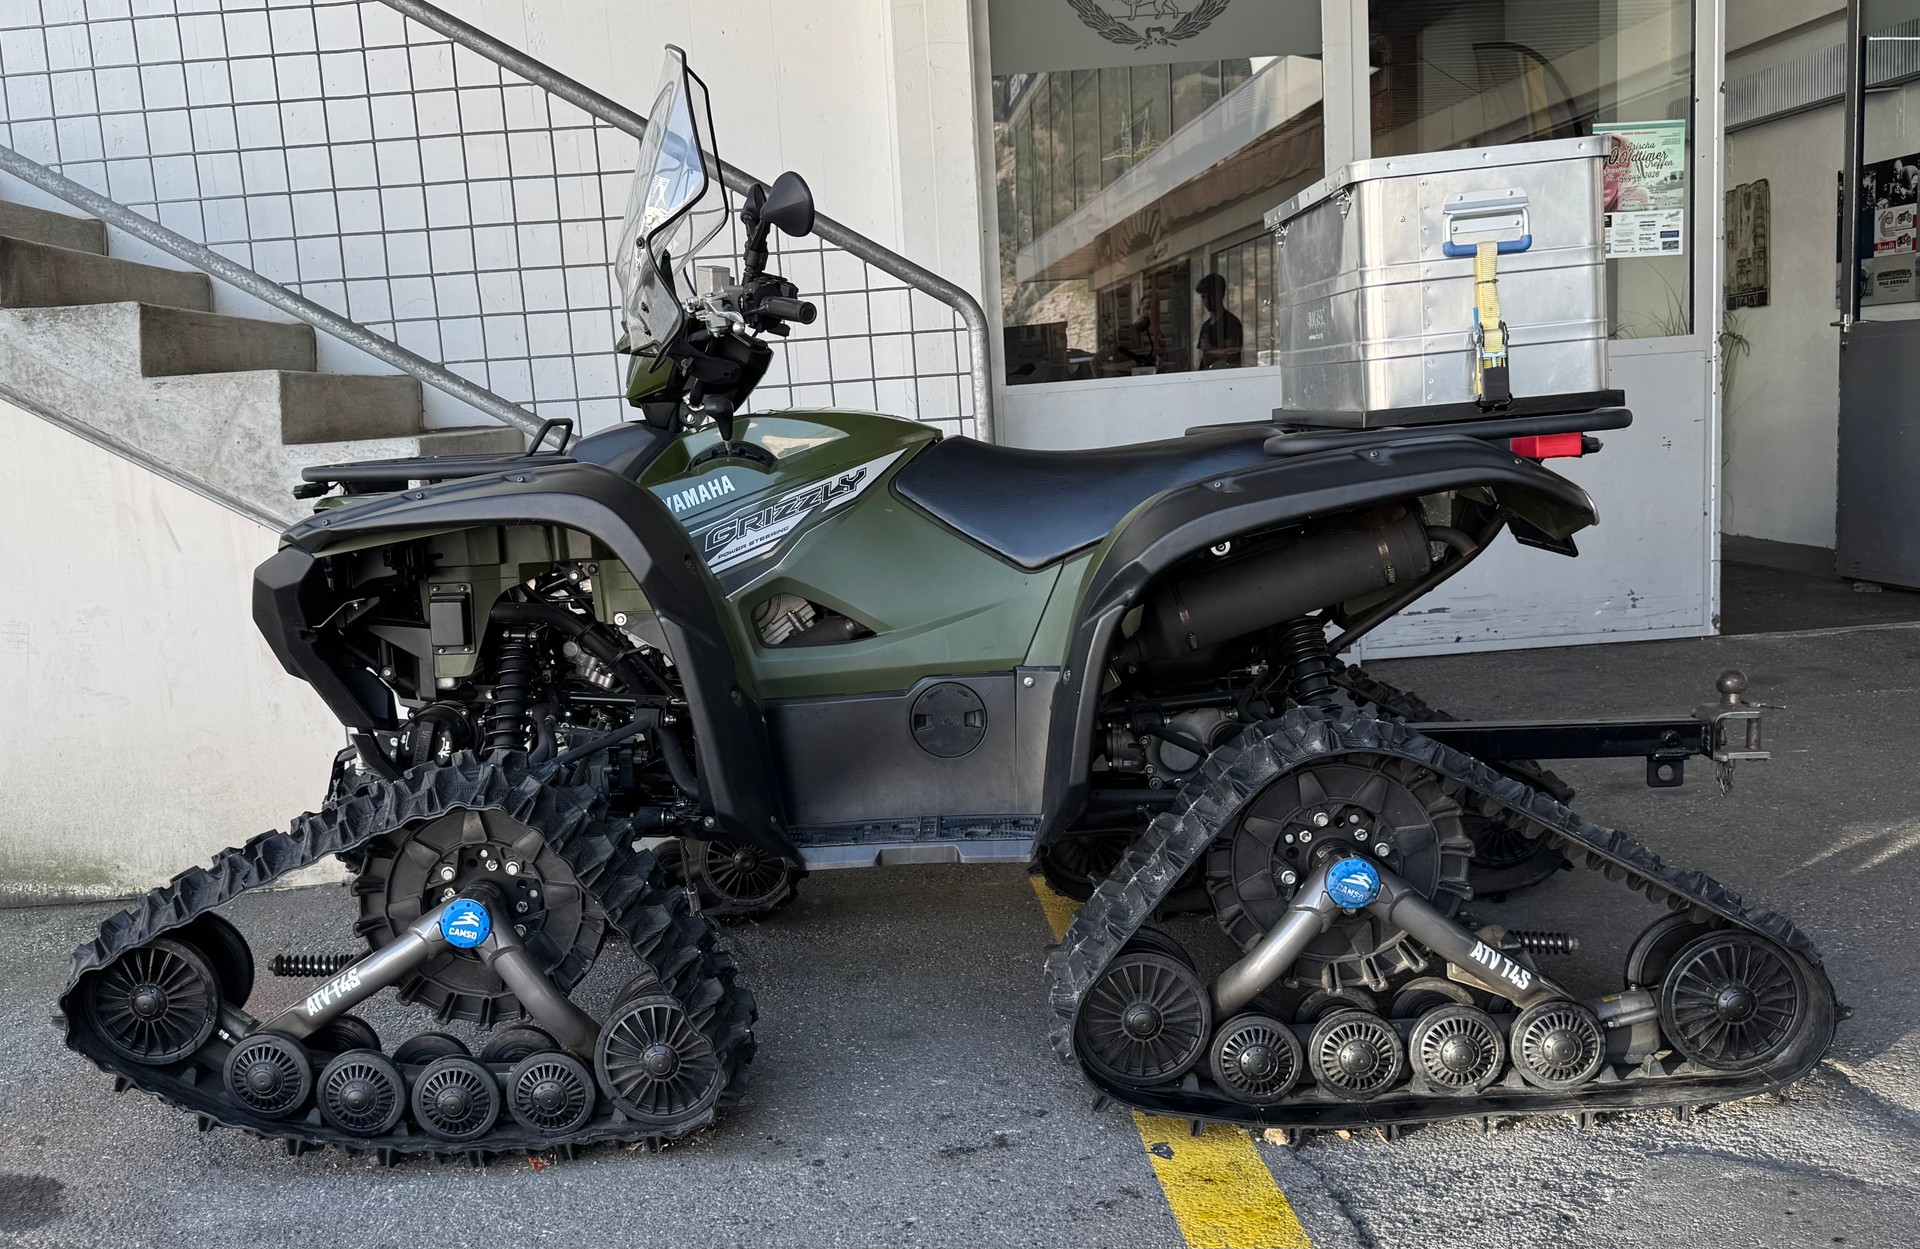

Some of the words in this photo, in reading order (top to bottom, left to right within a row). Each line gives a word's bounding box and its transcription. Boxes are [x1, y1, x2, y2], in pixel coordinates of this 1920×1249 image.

[1619, 150, 1669, 164] Oldtimer
[1644, 159, 1674, 170] Treffen
[1735, 294, 1759, 308] ITALY
[662, 475, 736, 513] YAMAHA
[705, 467, 867, 552] GRIZZLY
[718, 543, 747, 560] POWER
[748, 525, 789, 547] STEERING
[1335, 883, 1365, 901] CAMSO
[448, 927, 478, 940] CAMSO
[1470, 940, 1501, 970] ATV
[1501, 957, 1531, 990] T4S
